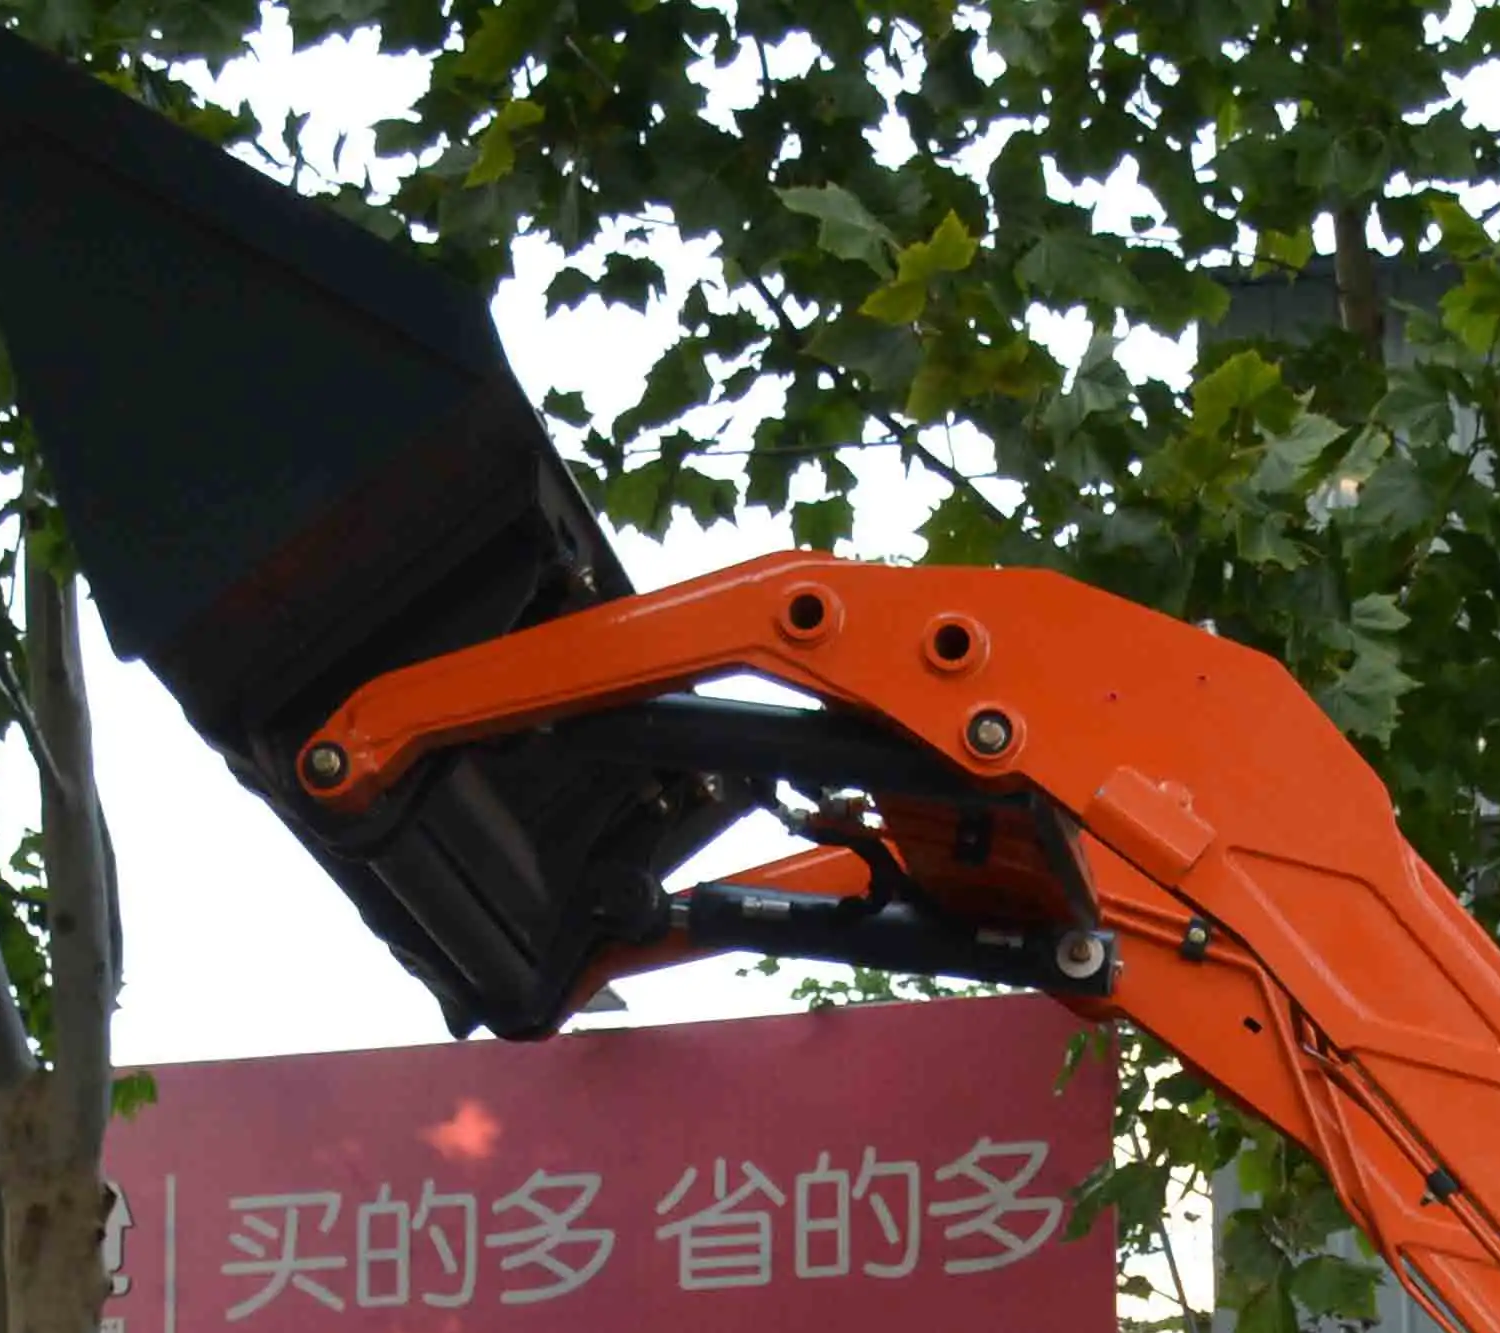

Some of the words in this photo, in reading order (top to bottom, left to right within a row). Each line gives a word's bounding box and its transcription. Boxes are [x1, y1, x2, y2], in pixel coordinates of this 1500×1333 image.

[220, 1168, 616, 1321] 买的多
[654, 1136, 1065, 1292] 省的多
